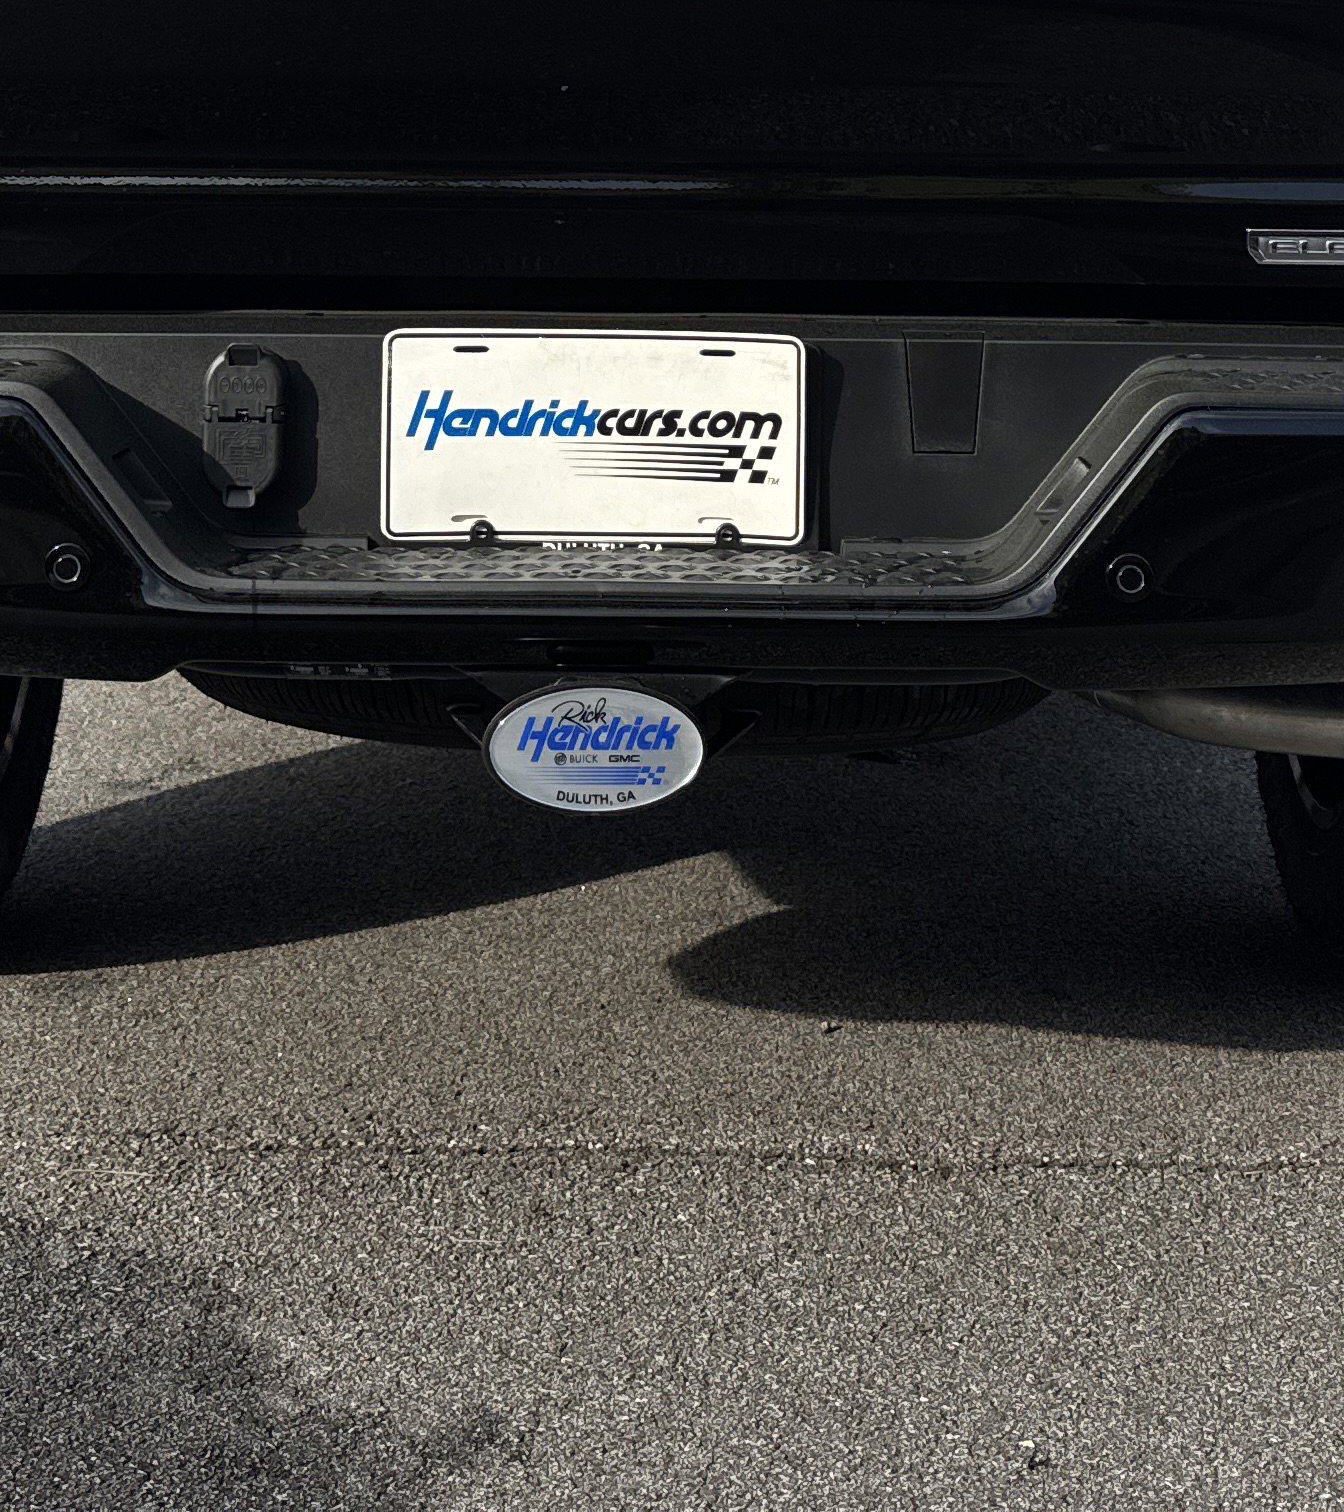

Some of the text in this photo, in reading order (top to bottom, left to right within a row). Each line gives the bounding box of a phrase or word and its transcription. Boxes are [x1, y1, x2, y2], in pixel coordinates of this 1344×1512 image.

[406, 389, 783, 451] Hendrickcars.com
[551, 697, 607, 732] Rick
[517, 716, 681, 762] Hendrick
[569, 754, 641, 764] BUICK GMC
[556, 790, 637, 806] DULUTH, GA
